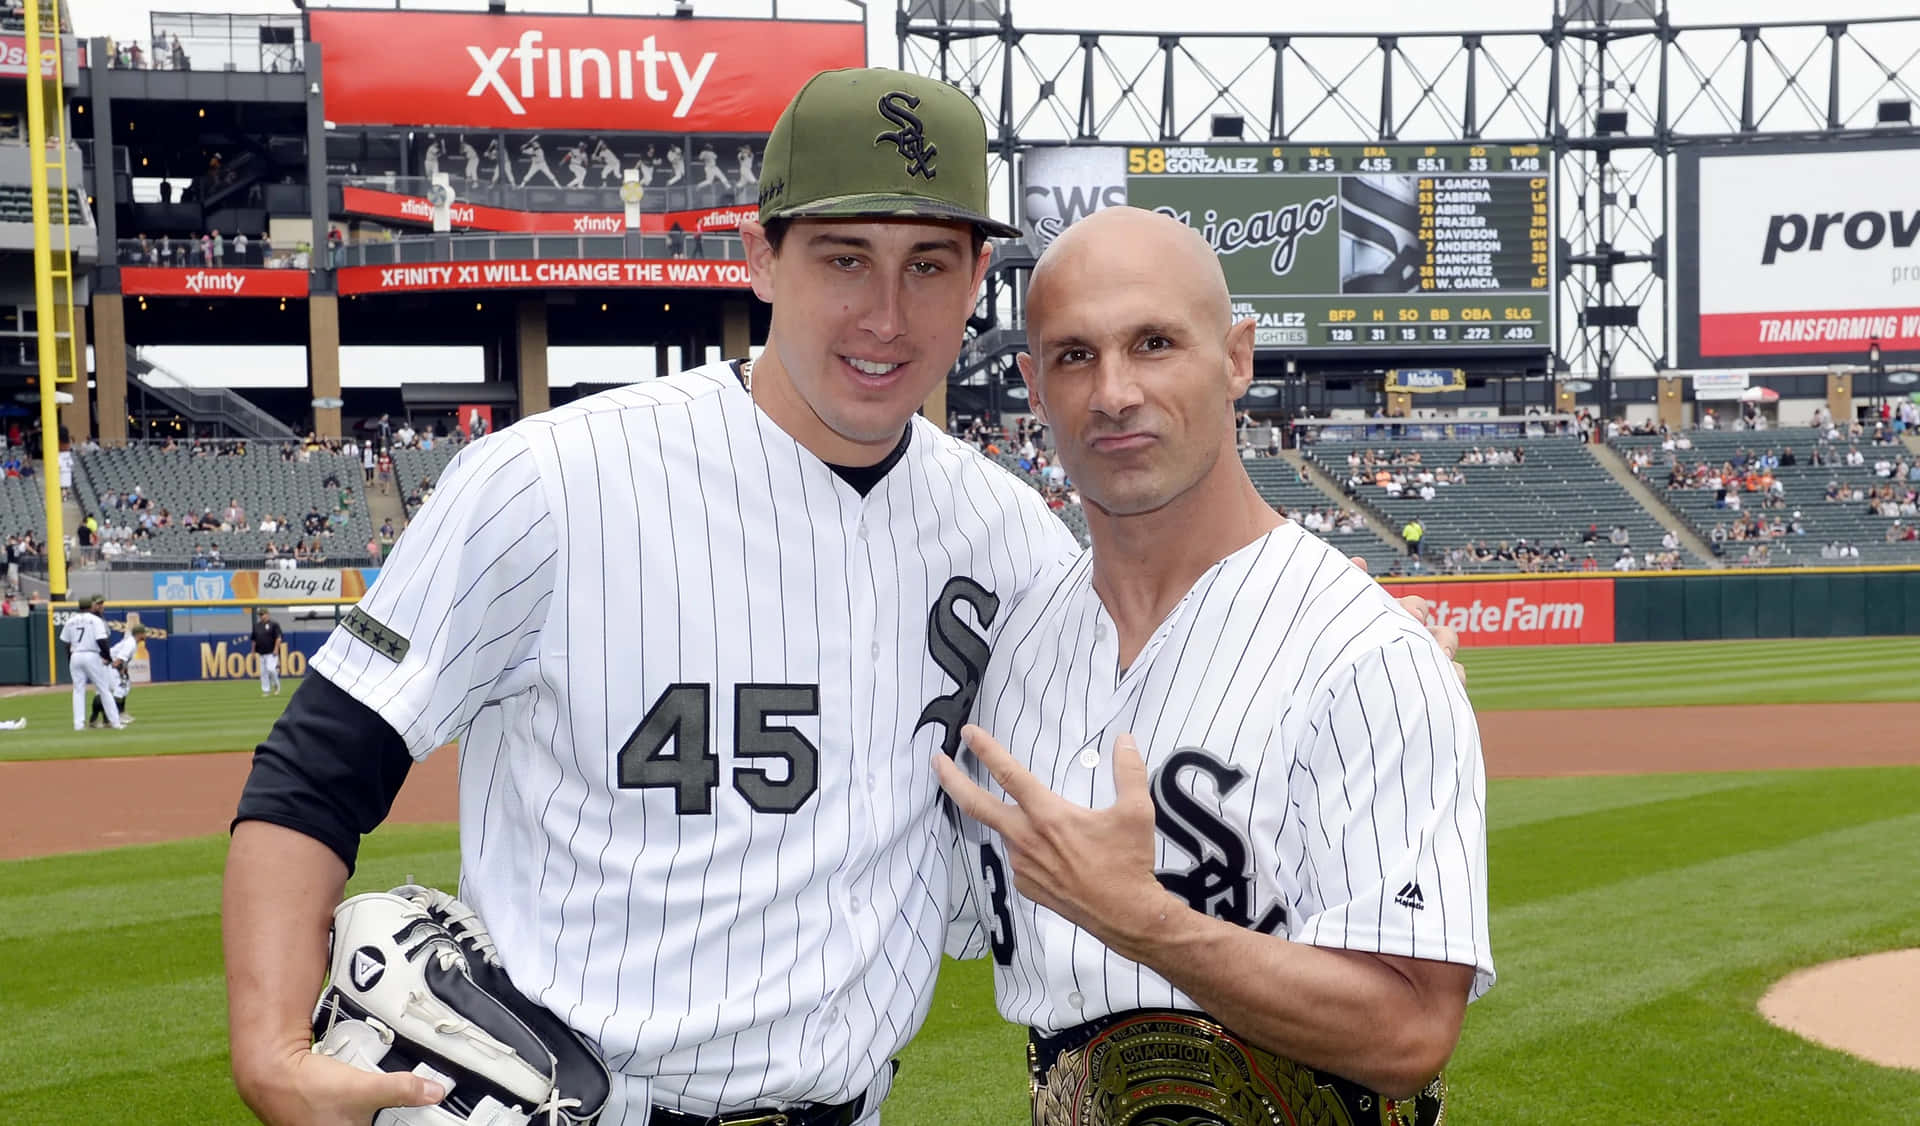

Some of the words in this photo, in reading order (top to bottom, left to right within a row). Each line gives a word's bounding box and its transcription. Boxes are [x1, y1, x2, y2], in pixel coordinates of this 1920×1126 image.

[466, 30, 718, 117] xfinity
[1165, 147, 1208, 158] MIGUEL
[1309, 148, 1331, 157] W-L
[1363, 148, 1387, 157] ERA
[1424, 148, 1436, 157] IP
[1510, 147, 1539, 157] WHIP
[1129, 148, 1164, 173] 58
[1273, 159, 1284, 172] 9
[1308, 159, 1335, 171] 3-5
[1360, 158, 1391, 171] 4.55
[1417, 158, 1445, 171] 55.1
[1469, 158, 1487, 171] 33
[1510, 158, 1539, 171] 1.48
[1530, 179, 1546, 189] CF
[1435, 192, 1492, 202] CABRERA
[1531, 192, 1546, 202] LF
[1435, 204, 1476, 215] ABREU
[573, 216, 621, 232] xfinity
[1435, 217, 1486, 227] FRAZIER
[1419, 229, 1434, 239] 24
[1435, 229, 1498, 239] DAVIDSON
[1530, 229, 1547, 239] DH
[1426, 241, 1434, 252] 7
[1435, 241, 1501, 252] ANDERSON
[1435, 254, 1491, 264] SANCHEZ
[381, 268, 452, 286] XFINITY
[458, 266, 479, 283] X1
[484, 264, 532, 282] WILL
[536, 263, 621, 281] CHANGE
[624, 264, 663, 281] THE
[667, 265, 709, 282] WAY
[1435, 266, 1493, 276] NARVAEZ
[1537, 266, 1547, 276] C
[185, 271, 245, 293] xfinity
[1435, 278, 1452, 289] W.
[1454, 278, 1500, 289] GARCIA
[1329, 310, 1356, 322] BFP
[1373, 309, 1383, 321] H
[1399, 310, 1418, 321] SO
[1430, 309, 1449, 321] BB
[1461, 308, 1492, 321] OBA
[1505, 308, 1531, 320] SLG
[1332, 329, 1352, 341] 128
[1371, 328, 1384, 340] 31
[1403, 328, 1416, 340] 15
[1433, 328, 1446, 340] 12
[1463, 327, 1490, 340] .272
[1504, 327, 1532, 339] .430
[1758, 316, 1898, 342] TRANSFORMING
[263, 572, 318, 596] Bring
[321, 577, 337, 592] it
[76, 627, 85, 643] 7
[617, 683, 820, 815] 45
[1123, 1045, 1207, 1062] CHAMPION
